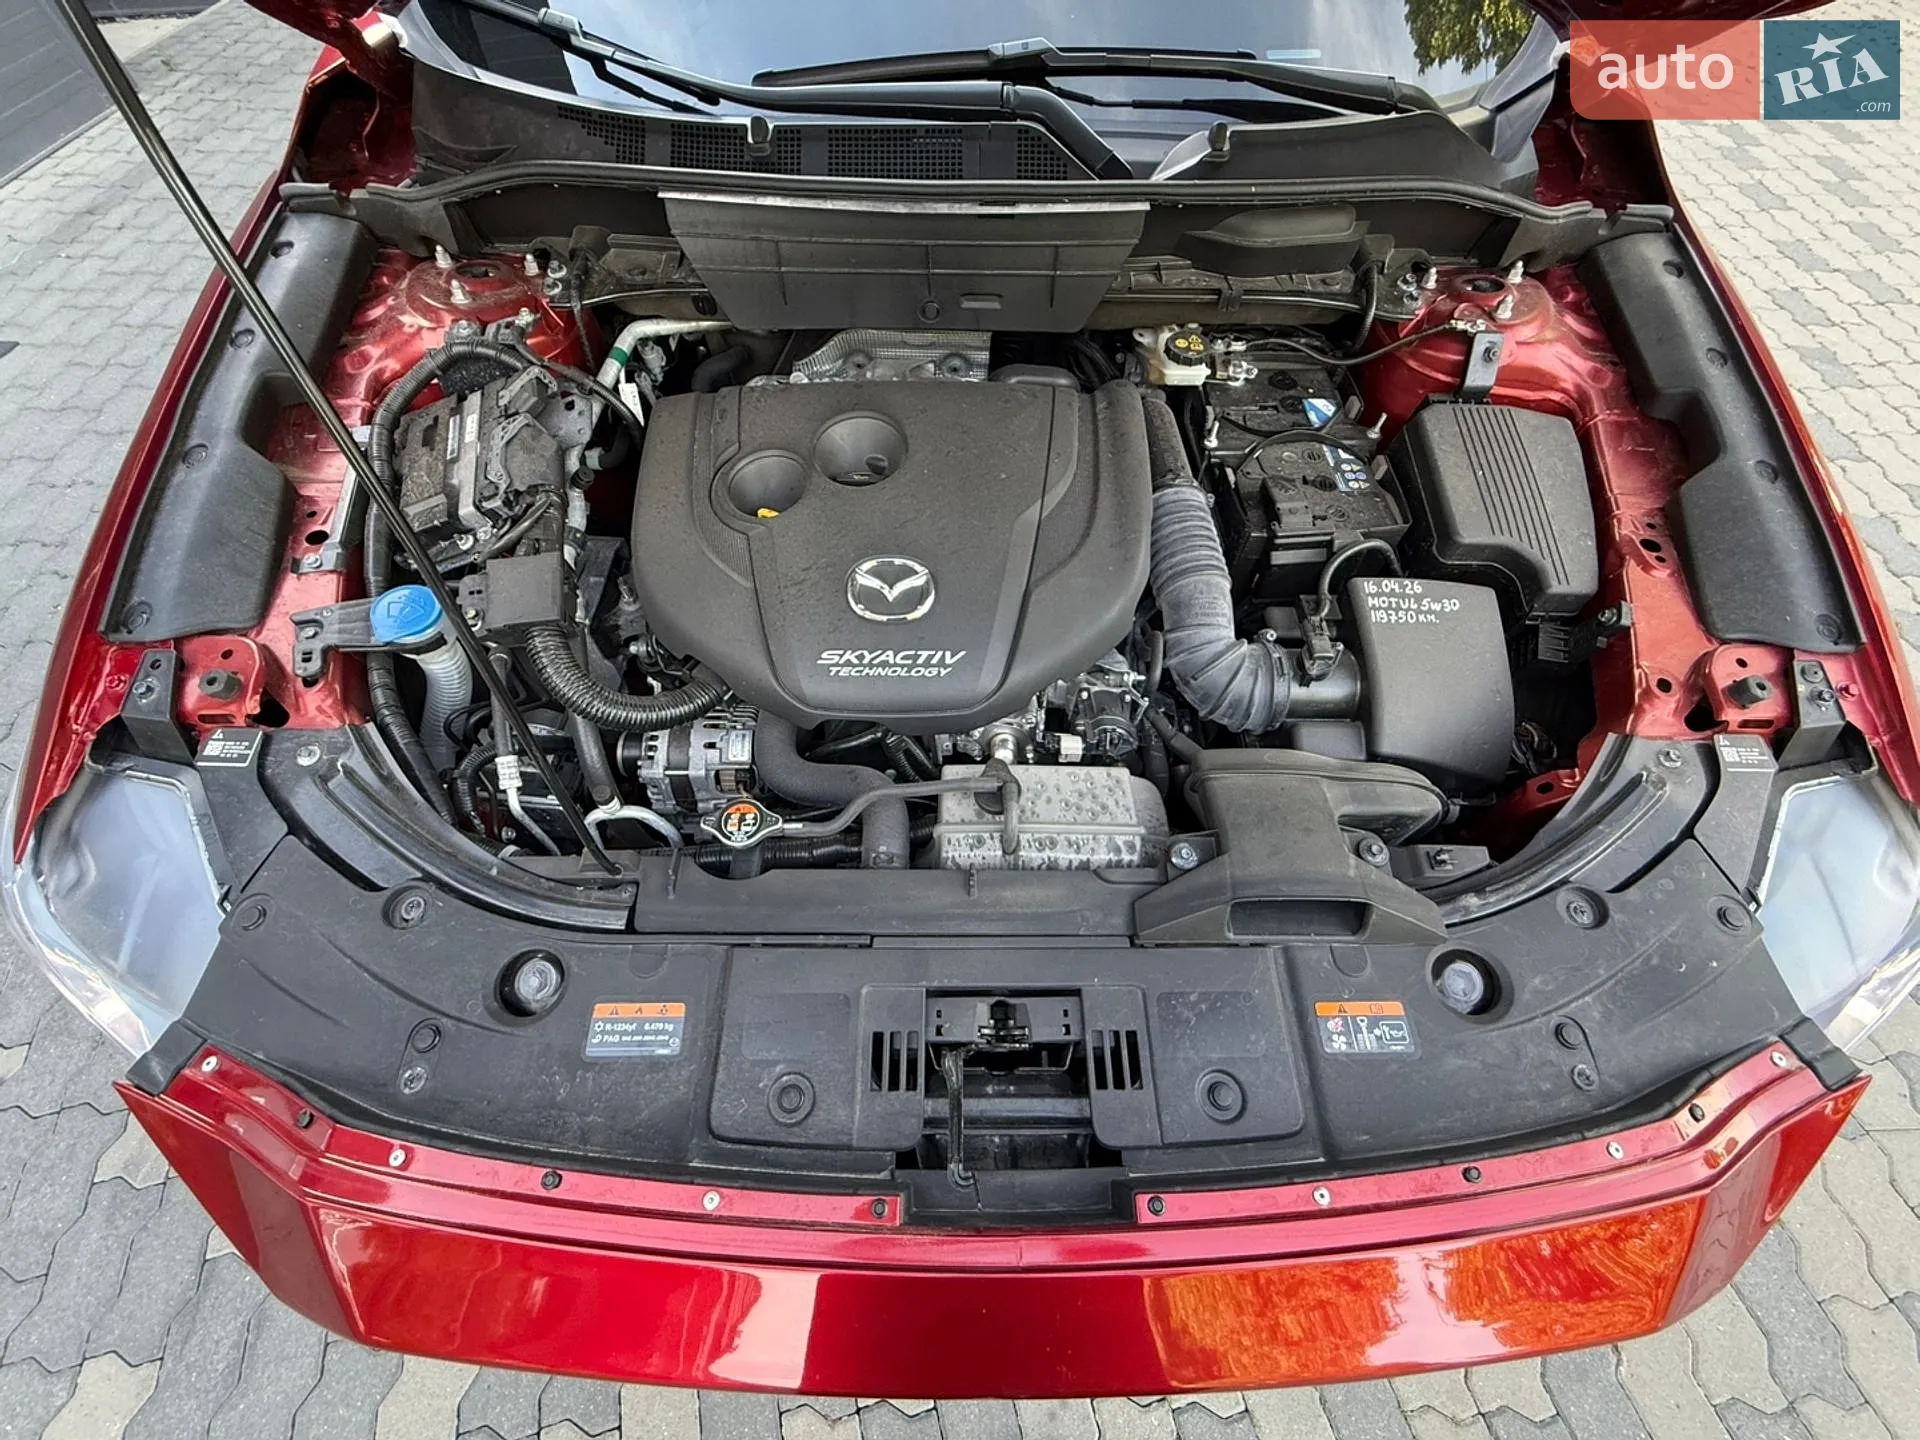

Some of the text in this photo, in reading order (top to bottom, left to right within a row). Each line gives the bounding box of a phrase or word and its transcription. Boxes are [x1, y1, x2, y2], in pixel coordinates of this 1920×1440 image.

[1363, 580, 1422, 594] 16.04.26
[1368, 596, 1418, 609] MOTUL
[1371, 609, 1416, 623] 119750
[816, 650, 967, 664] SKYACTIV
[829, 667, 952, 677] TECHNOLOGY
